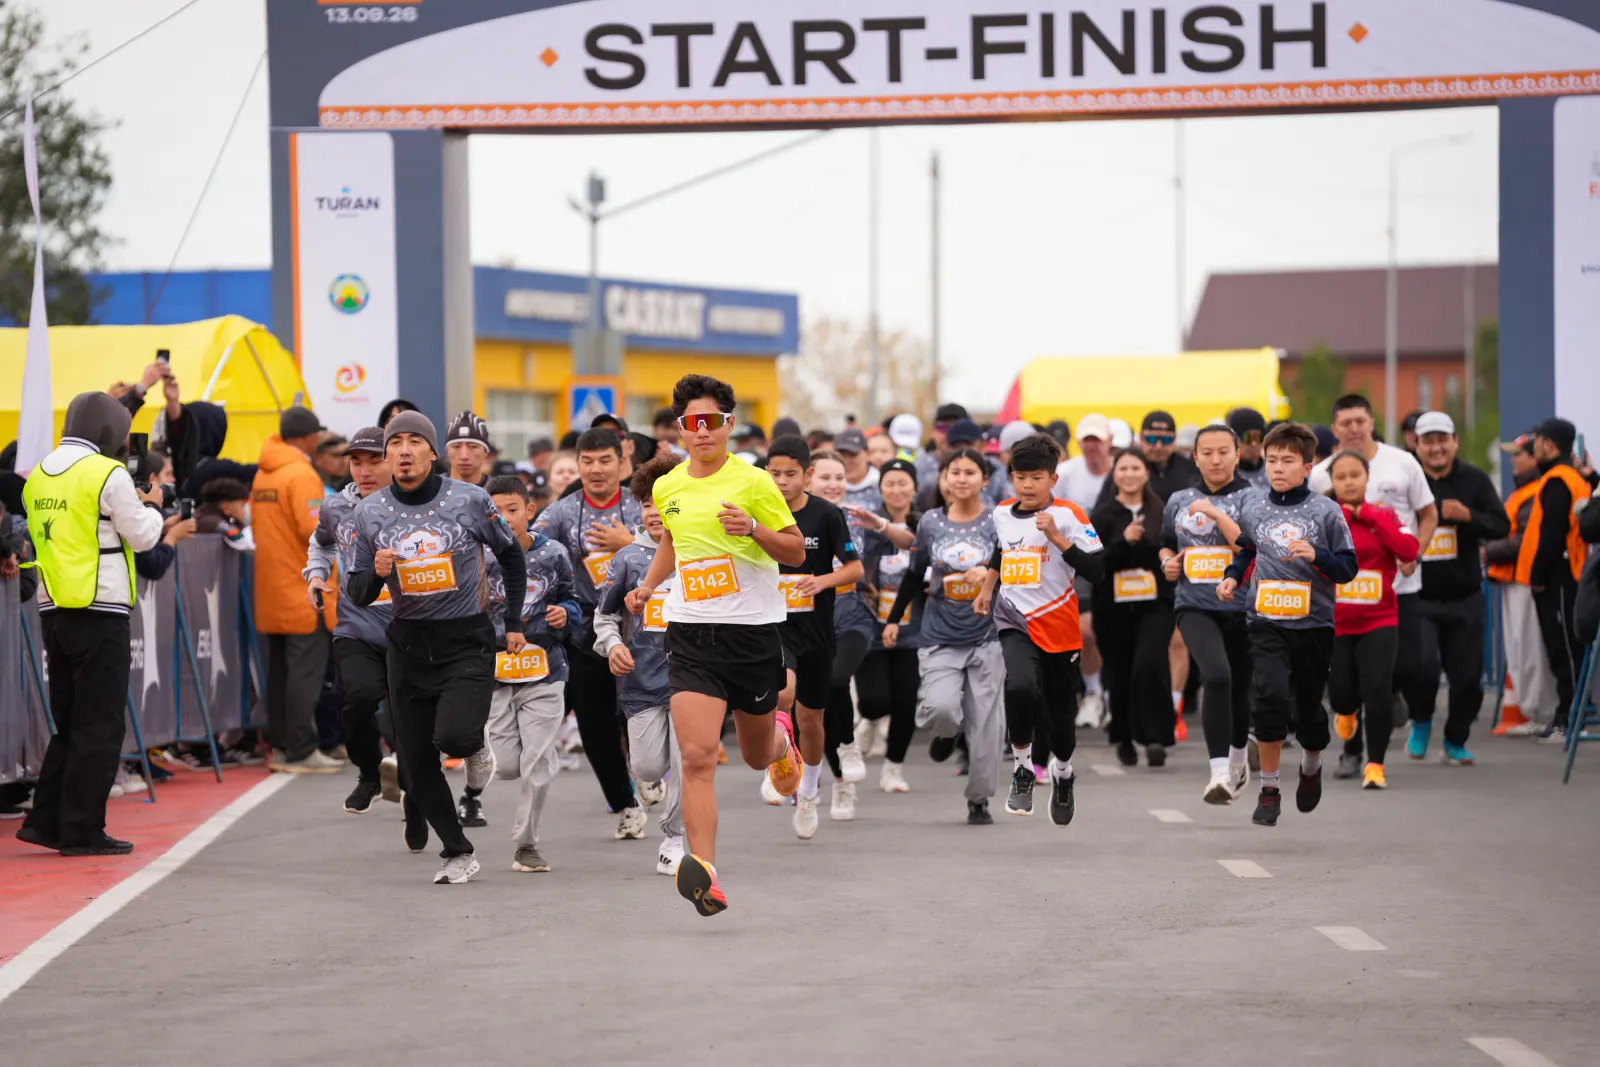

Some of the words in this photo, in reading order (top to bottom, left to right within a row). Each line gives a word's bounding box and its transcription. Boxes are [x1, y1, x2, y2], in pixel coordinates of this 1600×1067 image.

[583, 1, 1327, 90] START-FINISH
[314, 196, 381, 211] TURAN
[34, 498, 67, 511] MEDIA
[1003, 563, 1034, 577] 2175
[1191, 558, 1226, 572] 2025
[406, 569, 447, 585] 2059
[688, 572, 728, 592] 2142
[1263, 593, 1302, 608] 2088
[503, 655, 540, 671] 2169
